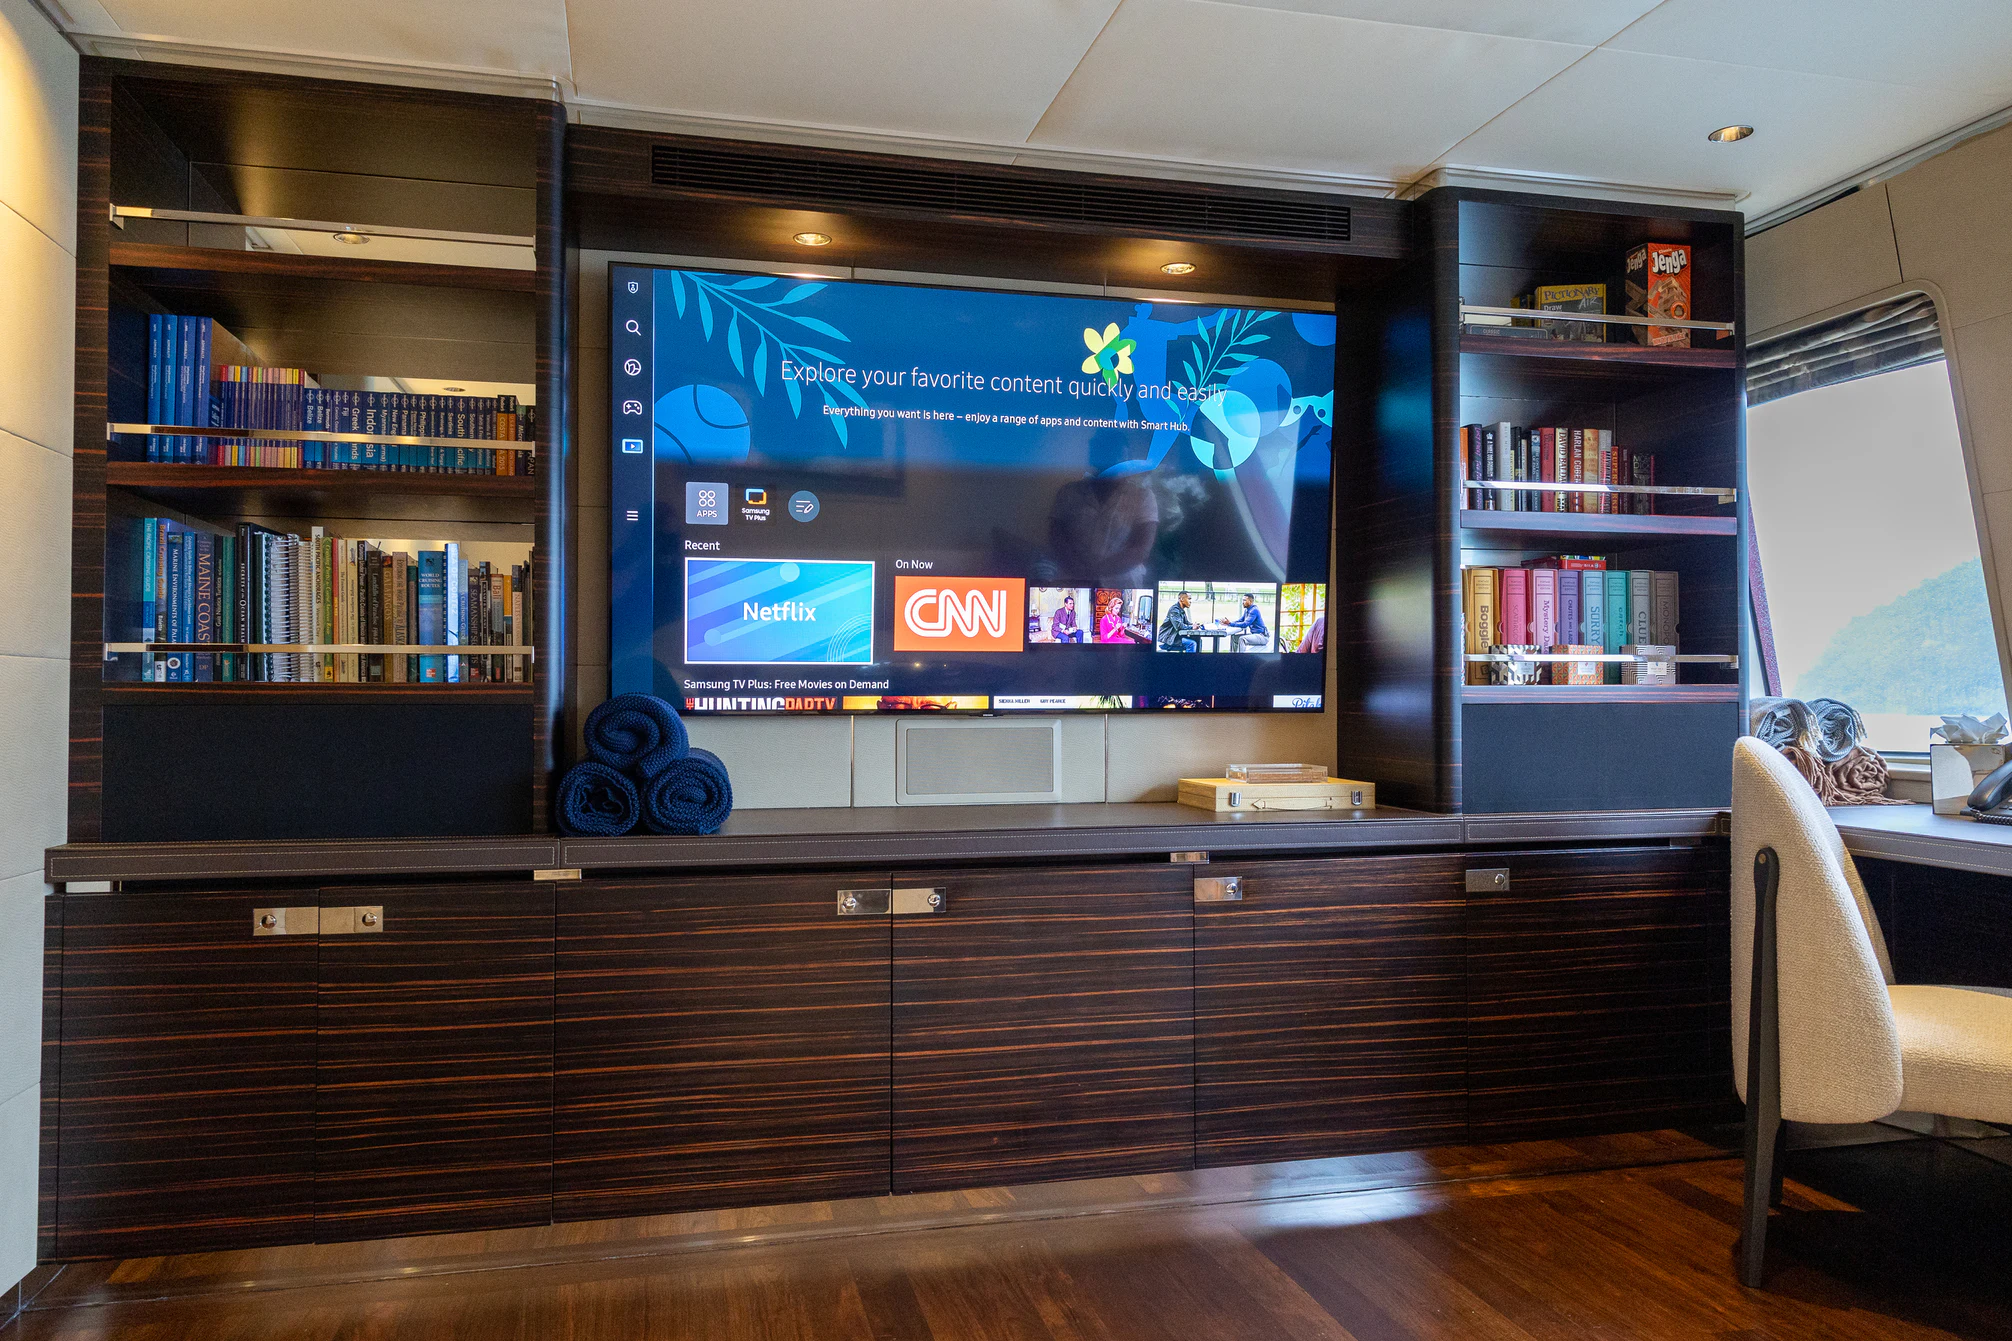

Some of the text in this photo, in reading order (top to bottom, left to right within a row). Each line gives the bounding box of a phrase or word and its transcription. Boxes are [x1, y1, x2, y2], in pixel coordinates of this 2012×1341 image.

[1626, 250, 1646, 274] Jenga
[1652, 250, 1686, 274] Jenga
[1544, 286, 1600, 300] PICTIONARY
[1578, 297, 1598, 310] AIR
[782, 360, 1228, 406] Explore your favorite content quickly and easily
[823, 405, 1190, 431] Everything you want is here enjoy a range of apps and content with Smart Hub.
[1559, 432, 1568, 455] DAVID
[1574, 430, 1582, 458] HARLAN
[742, 507, 770, 515] Samsung
[684, 540, 720, 550] Recent
[452, 567, 458, 578] OF
[896, 559, 933, 570] On Now
[198, 553, 210, 600] MAINE
[493, 585, 502, 599] Bali
[742, 602, 816, 622] Netflix
[904, 589, 1006, 638] CNN
[1479, 605, 1489, 648] Boggle
[1591, 606, 1600, 645] SORRY
[684, 680, 730, 691] Samsung
[732, 680, 745, 689] TV
[748, 680, 772, 689] Plus:
[774, 680, 796, 689] Free
[798, 680, 832, 689] Movies
[850, 680, 889, 689] Demand
